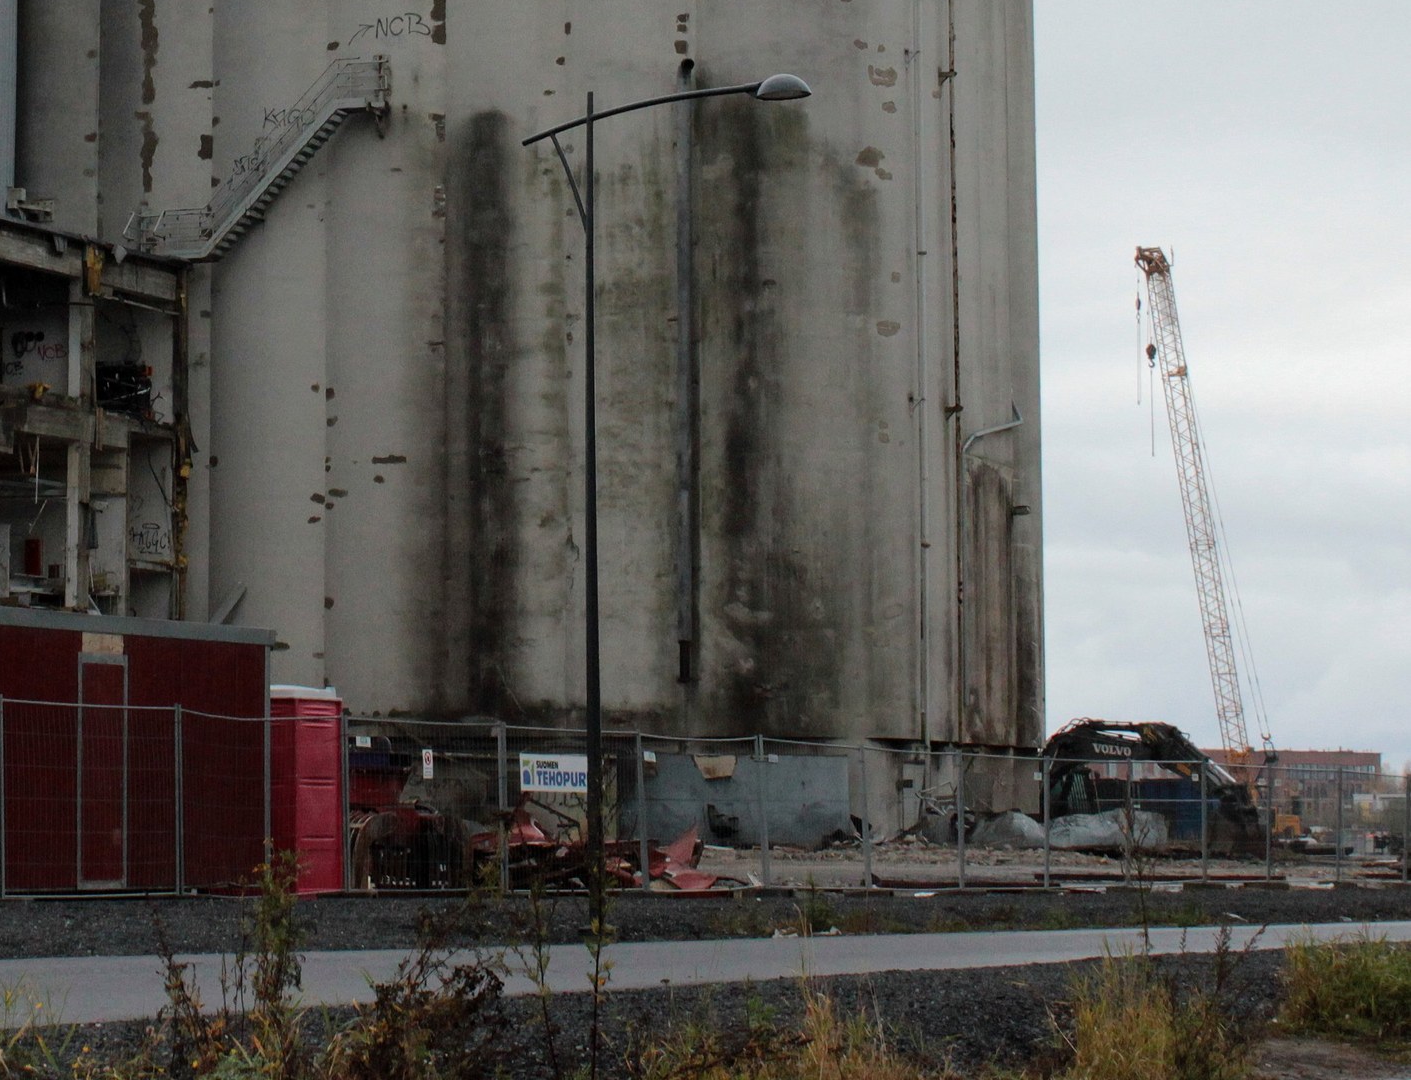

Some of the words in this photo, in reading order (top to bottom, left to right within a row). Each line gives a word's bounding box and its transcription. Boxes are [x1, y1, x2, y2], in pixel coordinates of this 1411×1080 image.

[375, 12, 431, 39] NCB
[1092, 742, 1133, 757] VOLVO
[535, 760, 559, 770] SUOMEN
